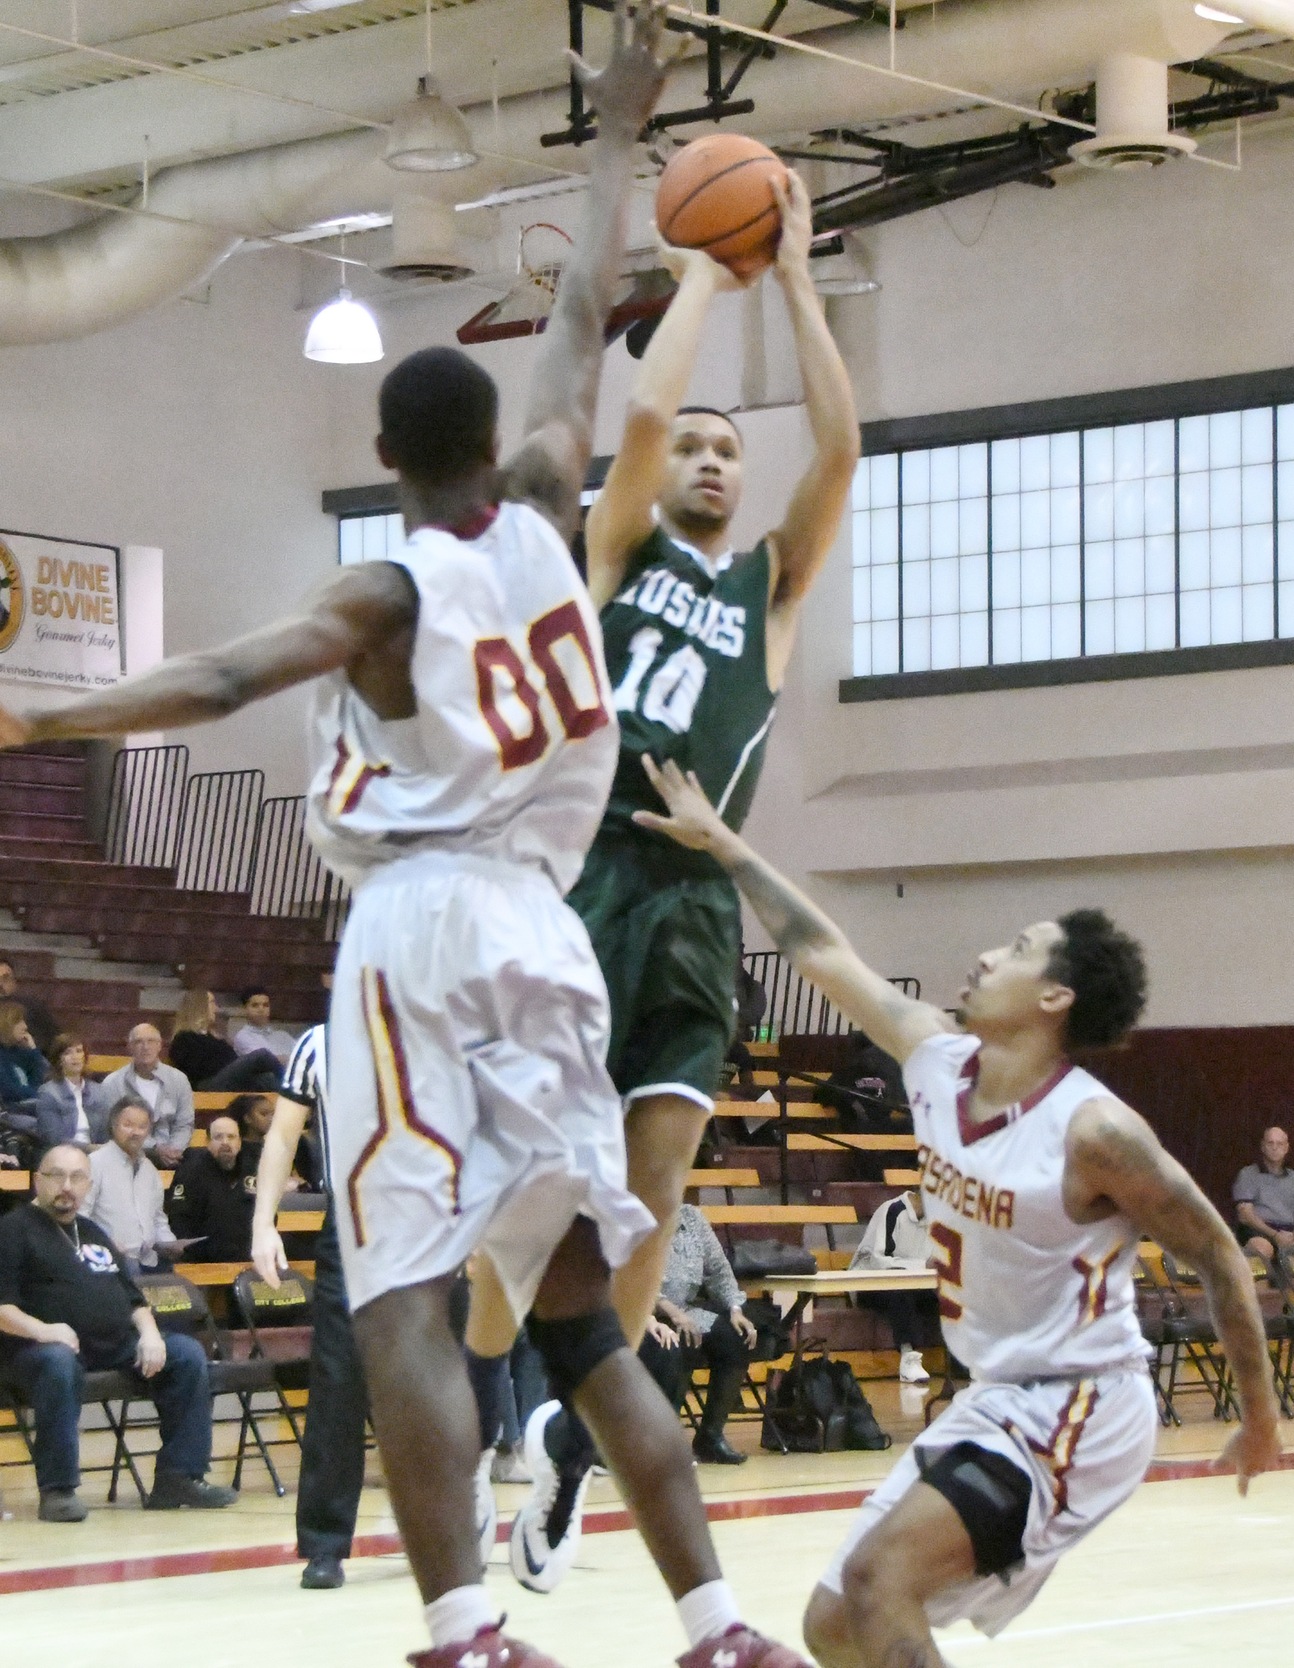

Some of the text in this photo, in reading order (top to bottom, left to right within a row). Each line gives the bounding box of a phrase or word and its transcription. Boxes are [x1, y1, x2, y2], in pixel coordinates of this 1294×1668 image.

[31, 586, 115, 625] BOVINE
[37, 556, 110, 593] DIVINE
[34, 622, 116, 650] Gourmet Jerky
[473, 599, 609, 773] 00
[611, 626, 707, 735] 10
[917, 1144, 1015, 1229] ASADENA
[928, 1220, 963, 1322] 2
